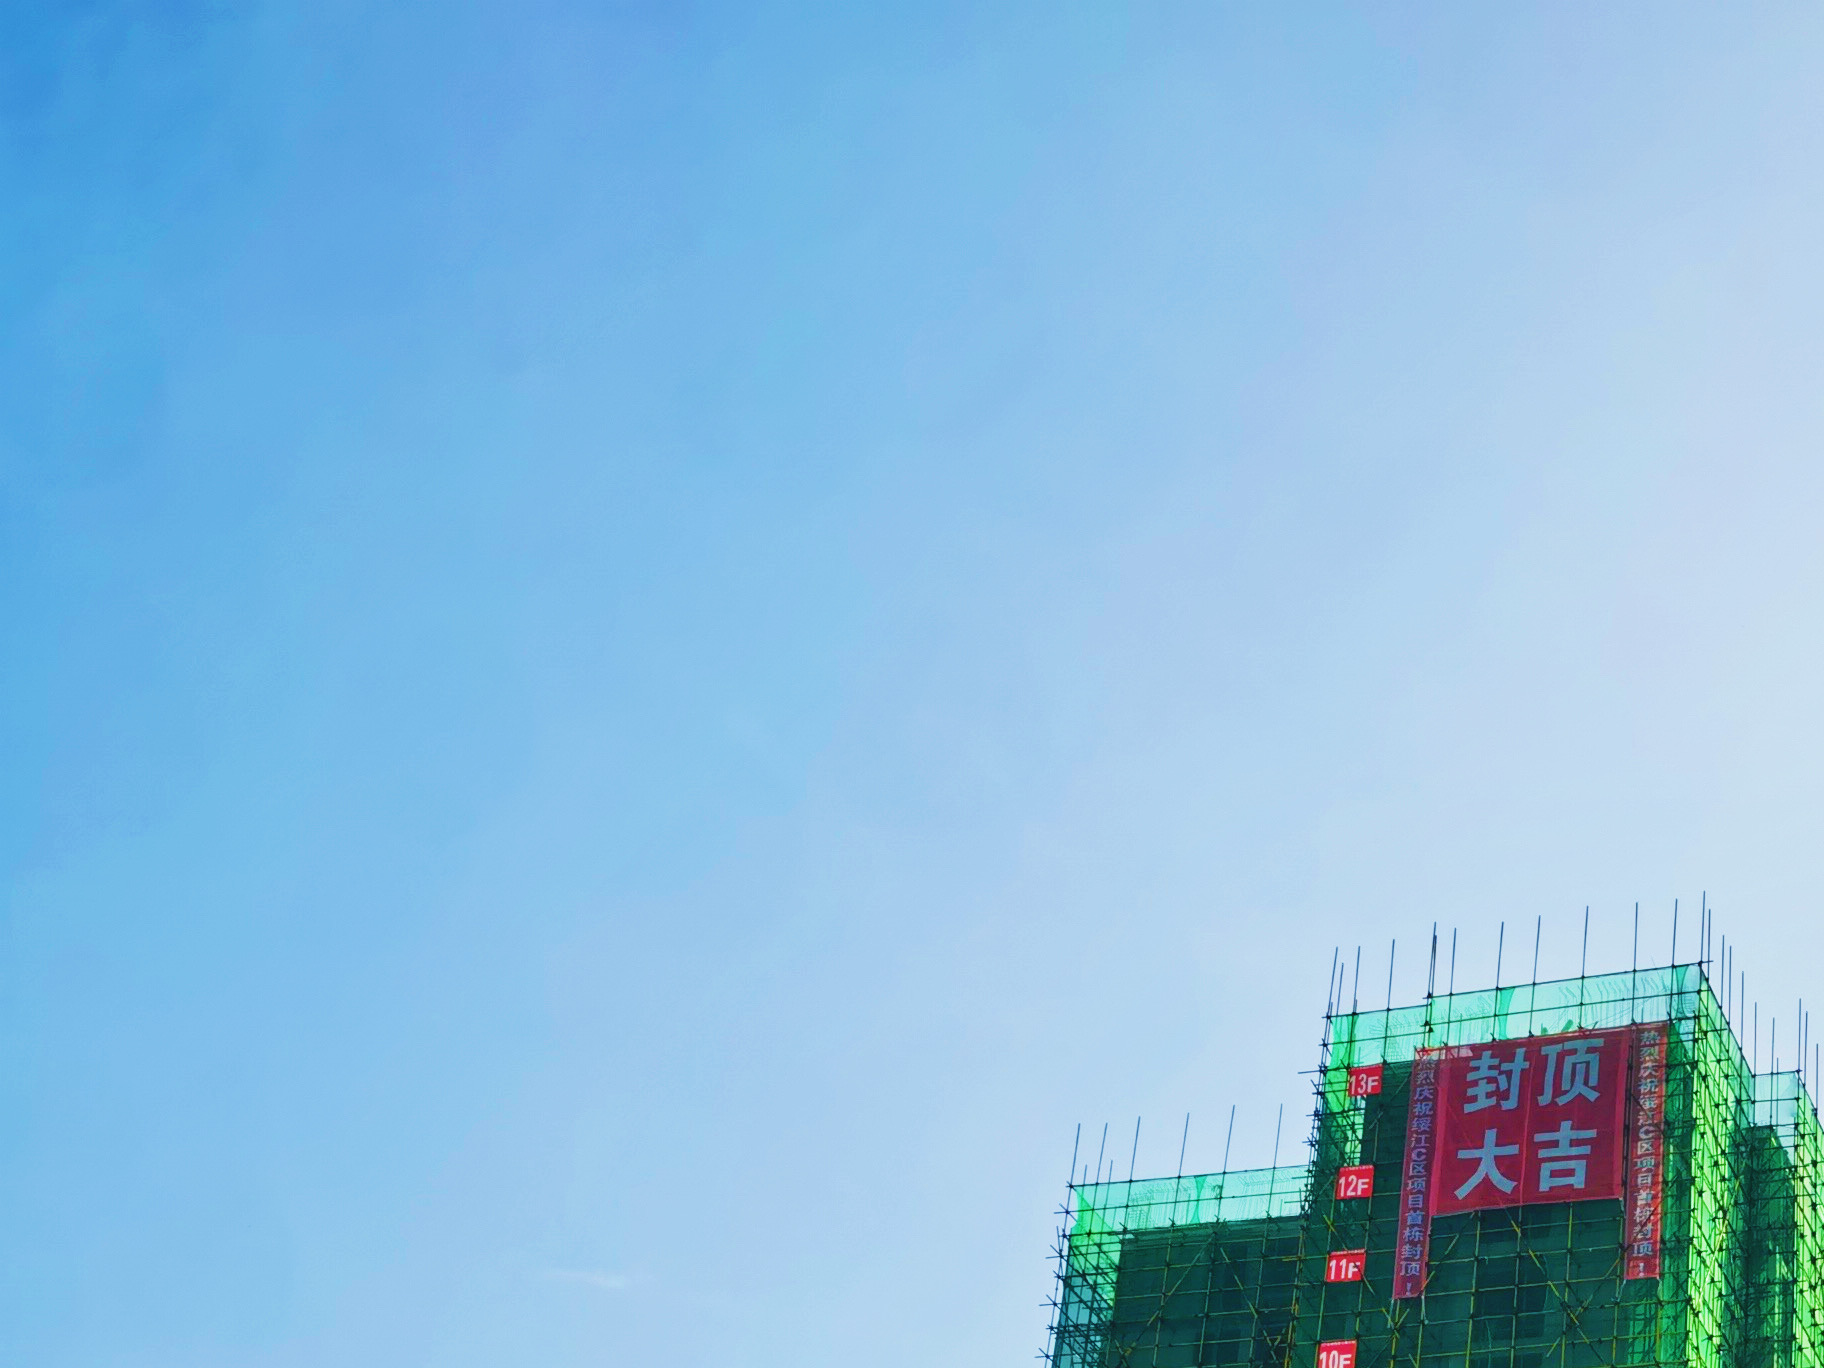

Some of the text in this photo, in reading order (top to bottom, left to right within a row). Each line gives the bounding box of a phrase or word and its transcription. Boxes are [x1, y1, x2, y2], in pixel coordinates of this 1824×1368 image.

[1349, 1073, 1380, 1095] 13F
[1464, 1038, 1604, 1114] 封顶
[1454, 1120, 1598, 1201] 大吉
[1339, 1175, 1370, 1197] 12F
[1330, 1259, 1361, 1280] 11F
